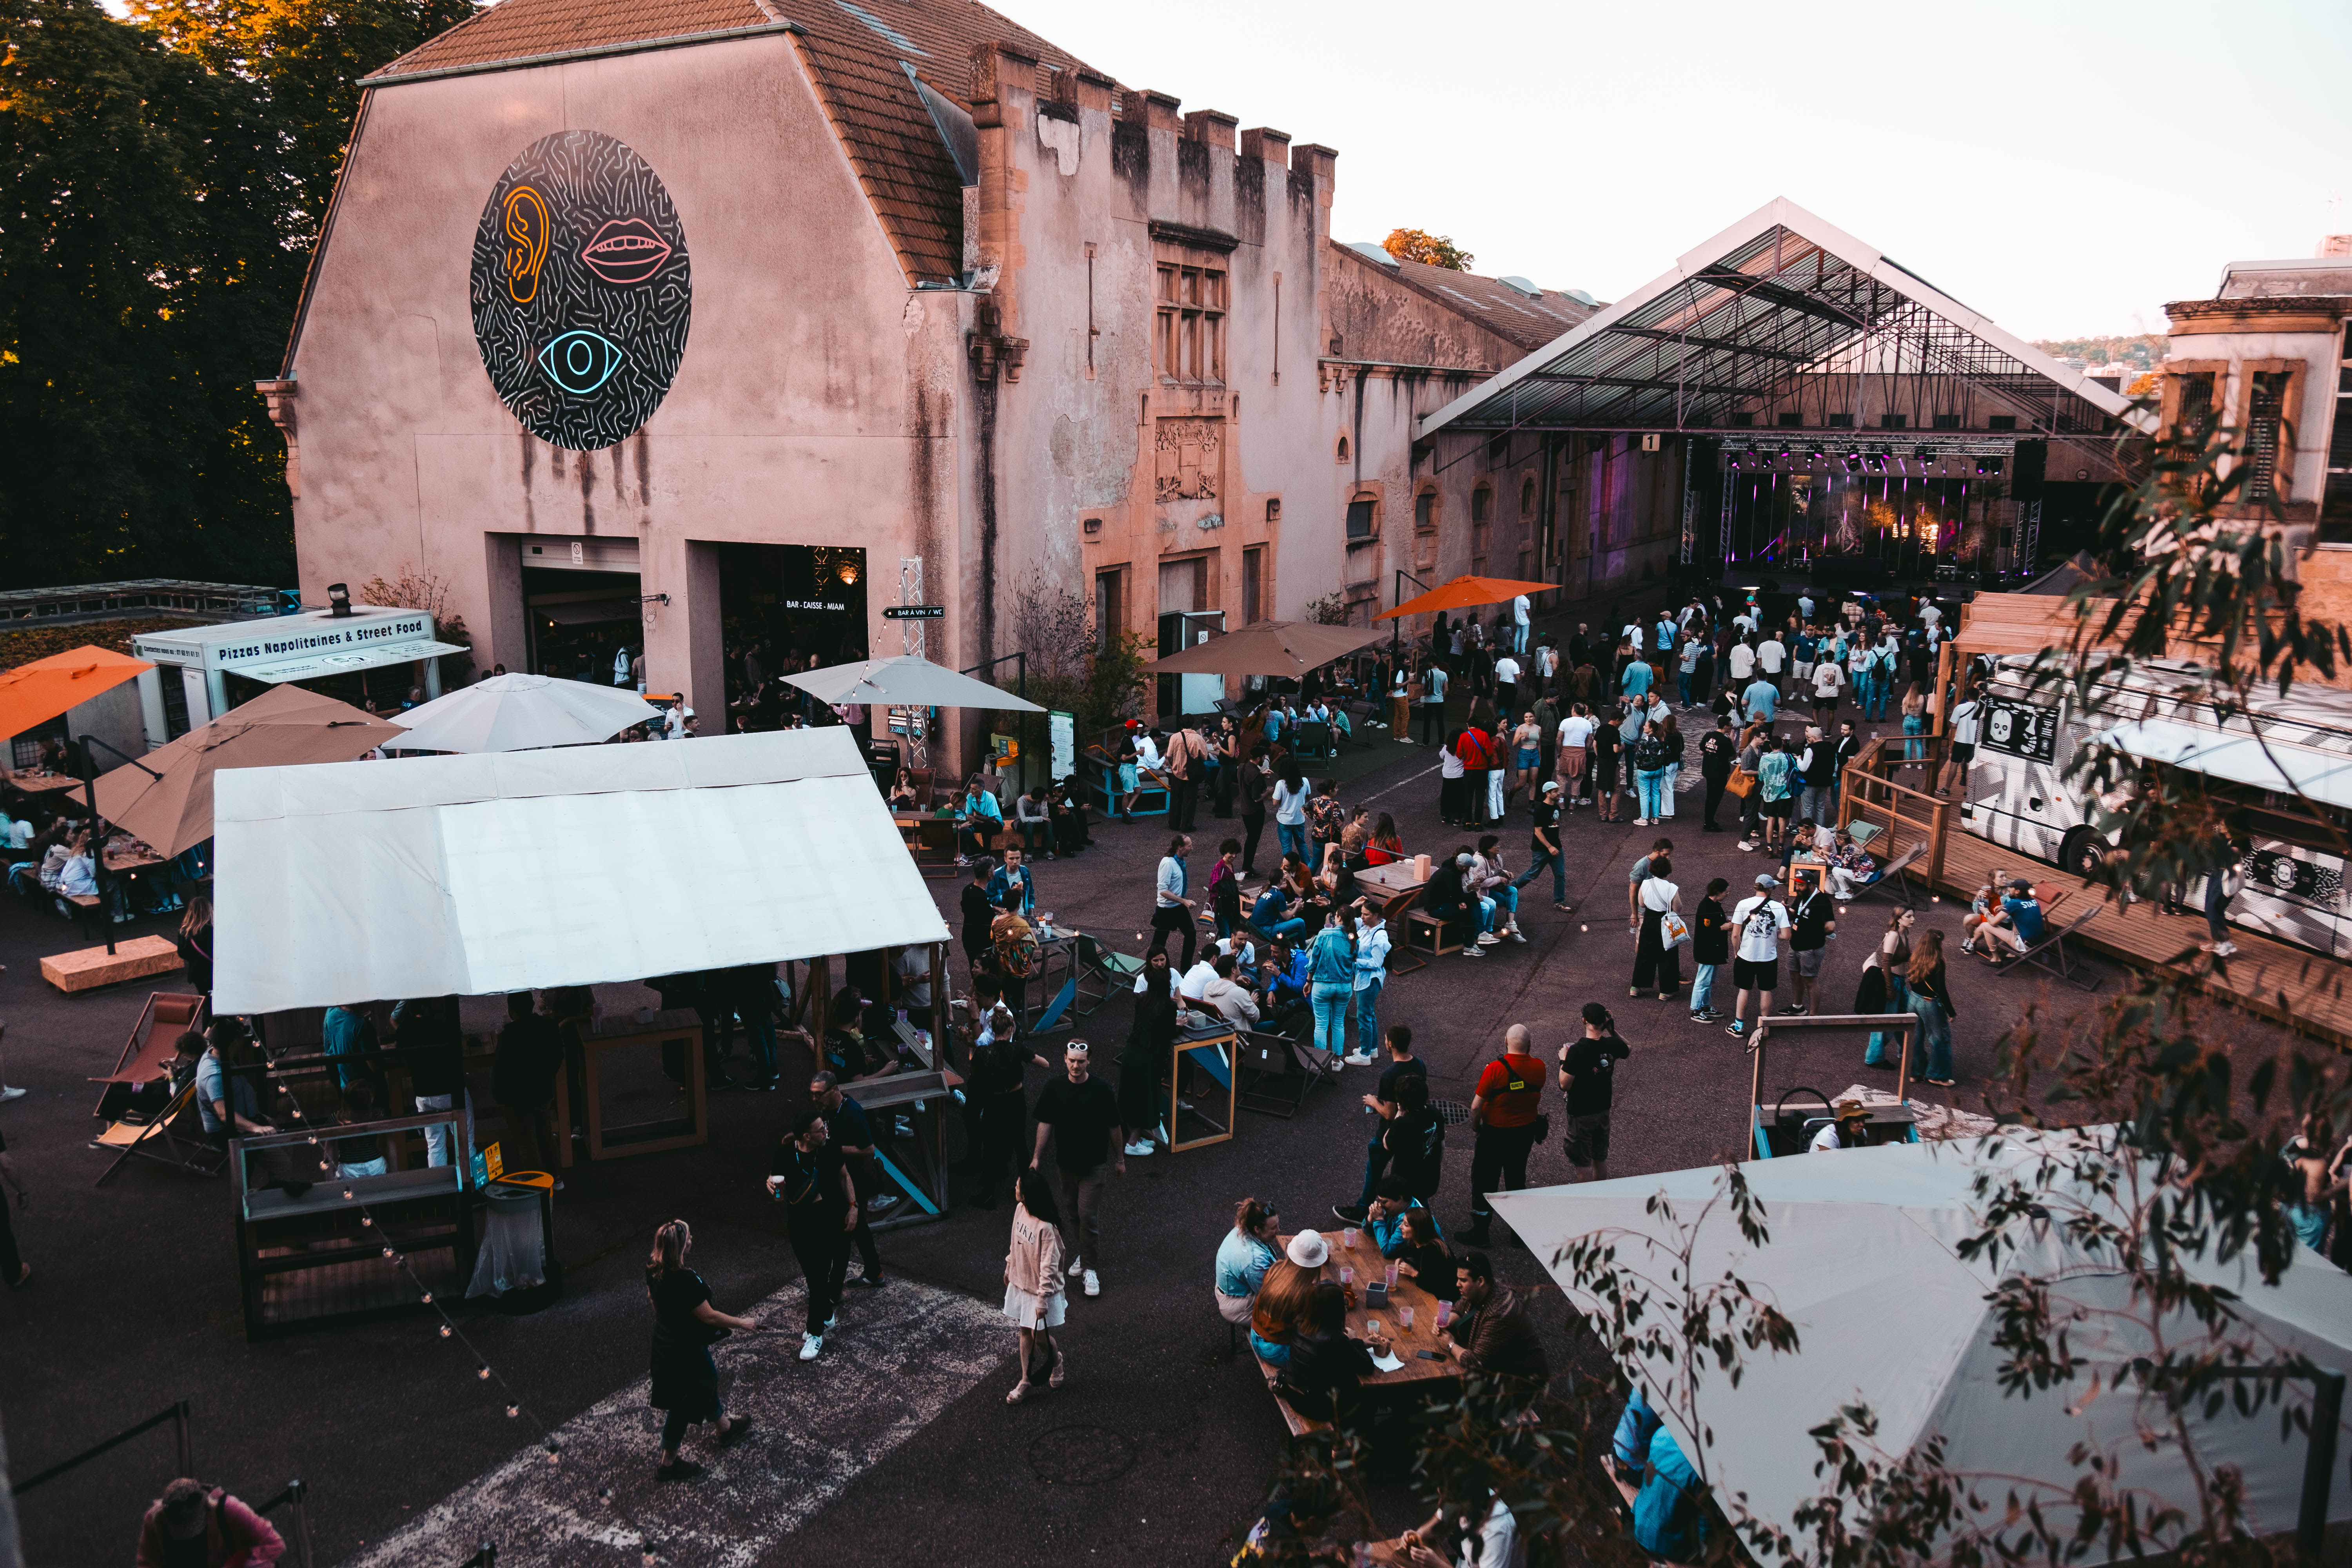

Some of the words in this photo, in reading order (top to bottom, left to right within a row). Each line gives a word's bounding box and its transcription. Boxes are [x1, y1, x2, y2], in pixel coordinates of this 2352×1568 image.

[1647, 435, 1653, 449] 1
[219, 646, 260, 661] Pizzas
[264, 634, 341, 654] Napolitaines
[346, 631, 353, 642] &
[357, 625, 392, 641] Street
[396, 621, 422, 634] Food
